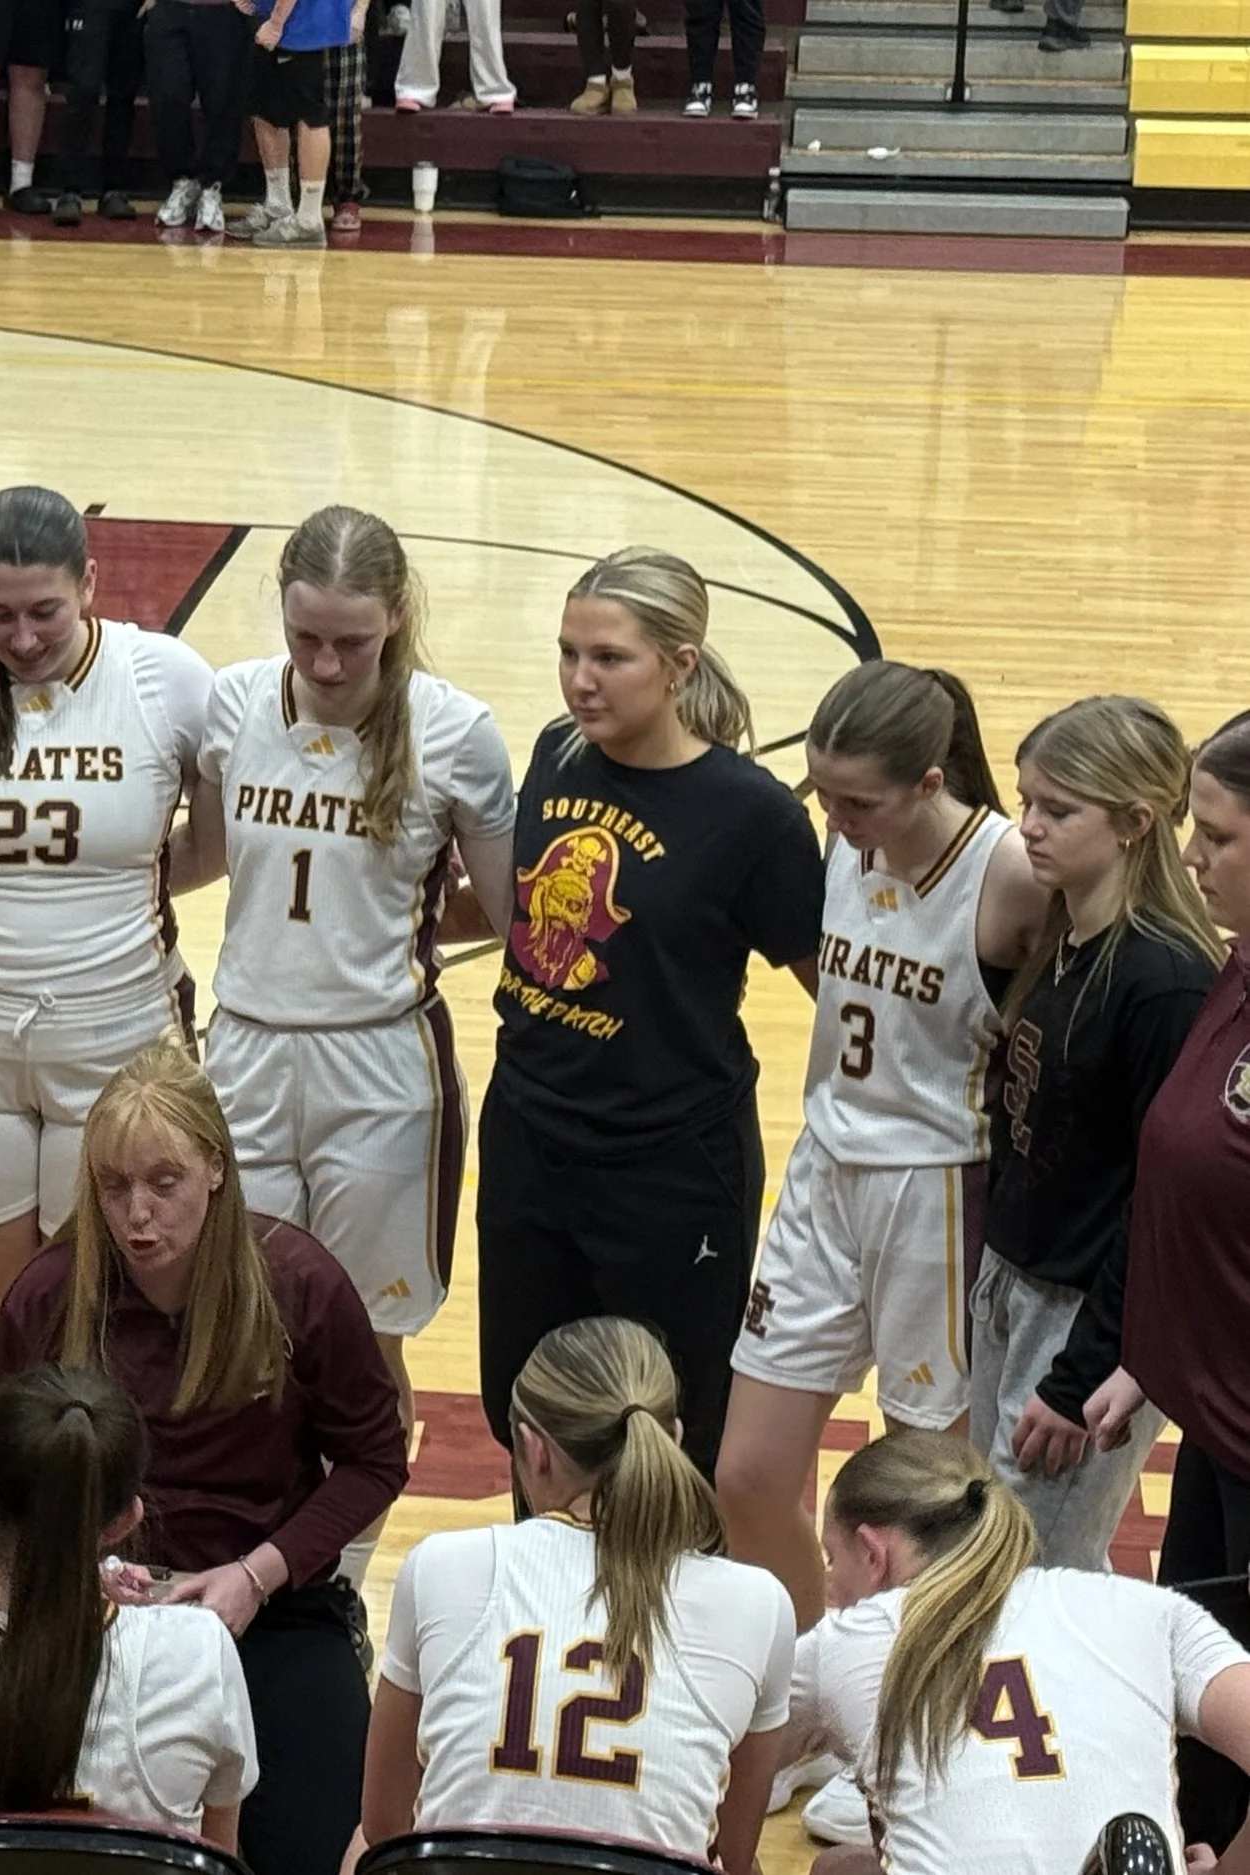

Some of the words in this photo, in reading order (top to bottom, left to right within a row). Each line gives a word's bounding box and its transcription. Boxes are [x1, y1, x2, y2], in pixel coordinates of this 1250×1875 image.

[234, 783, 370, 838] PIRATE
[541, 797, 666, 862] SOUTHEAST
[288, 848, 313, 924] 1
[545, 1001, 625, 1041] PATCH
[840, 1000, 877, 1081] 3
[489, 1628, 647, 1792] 12
[967, 1653, 1067, 1783] 4
